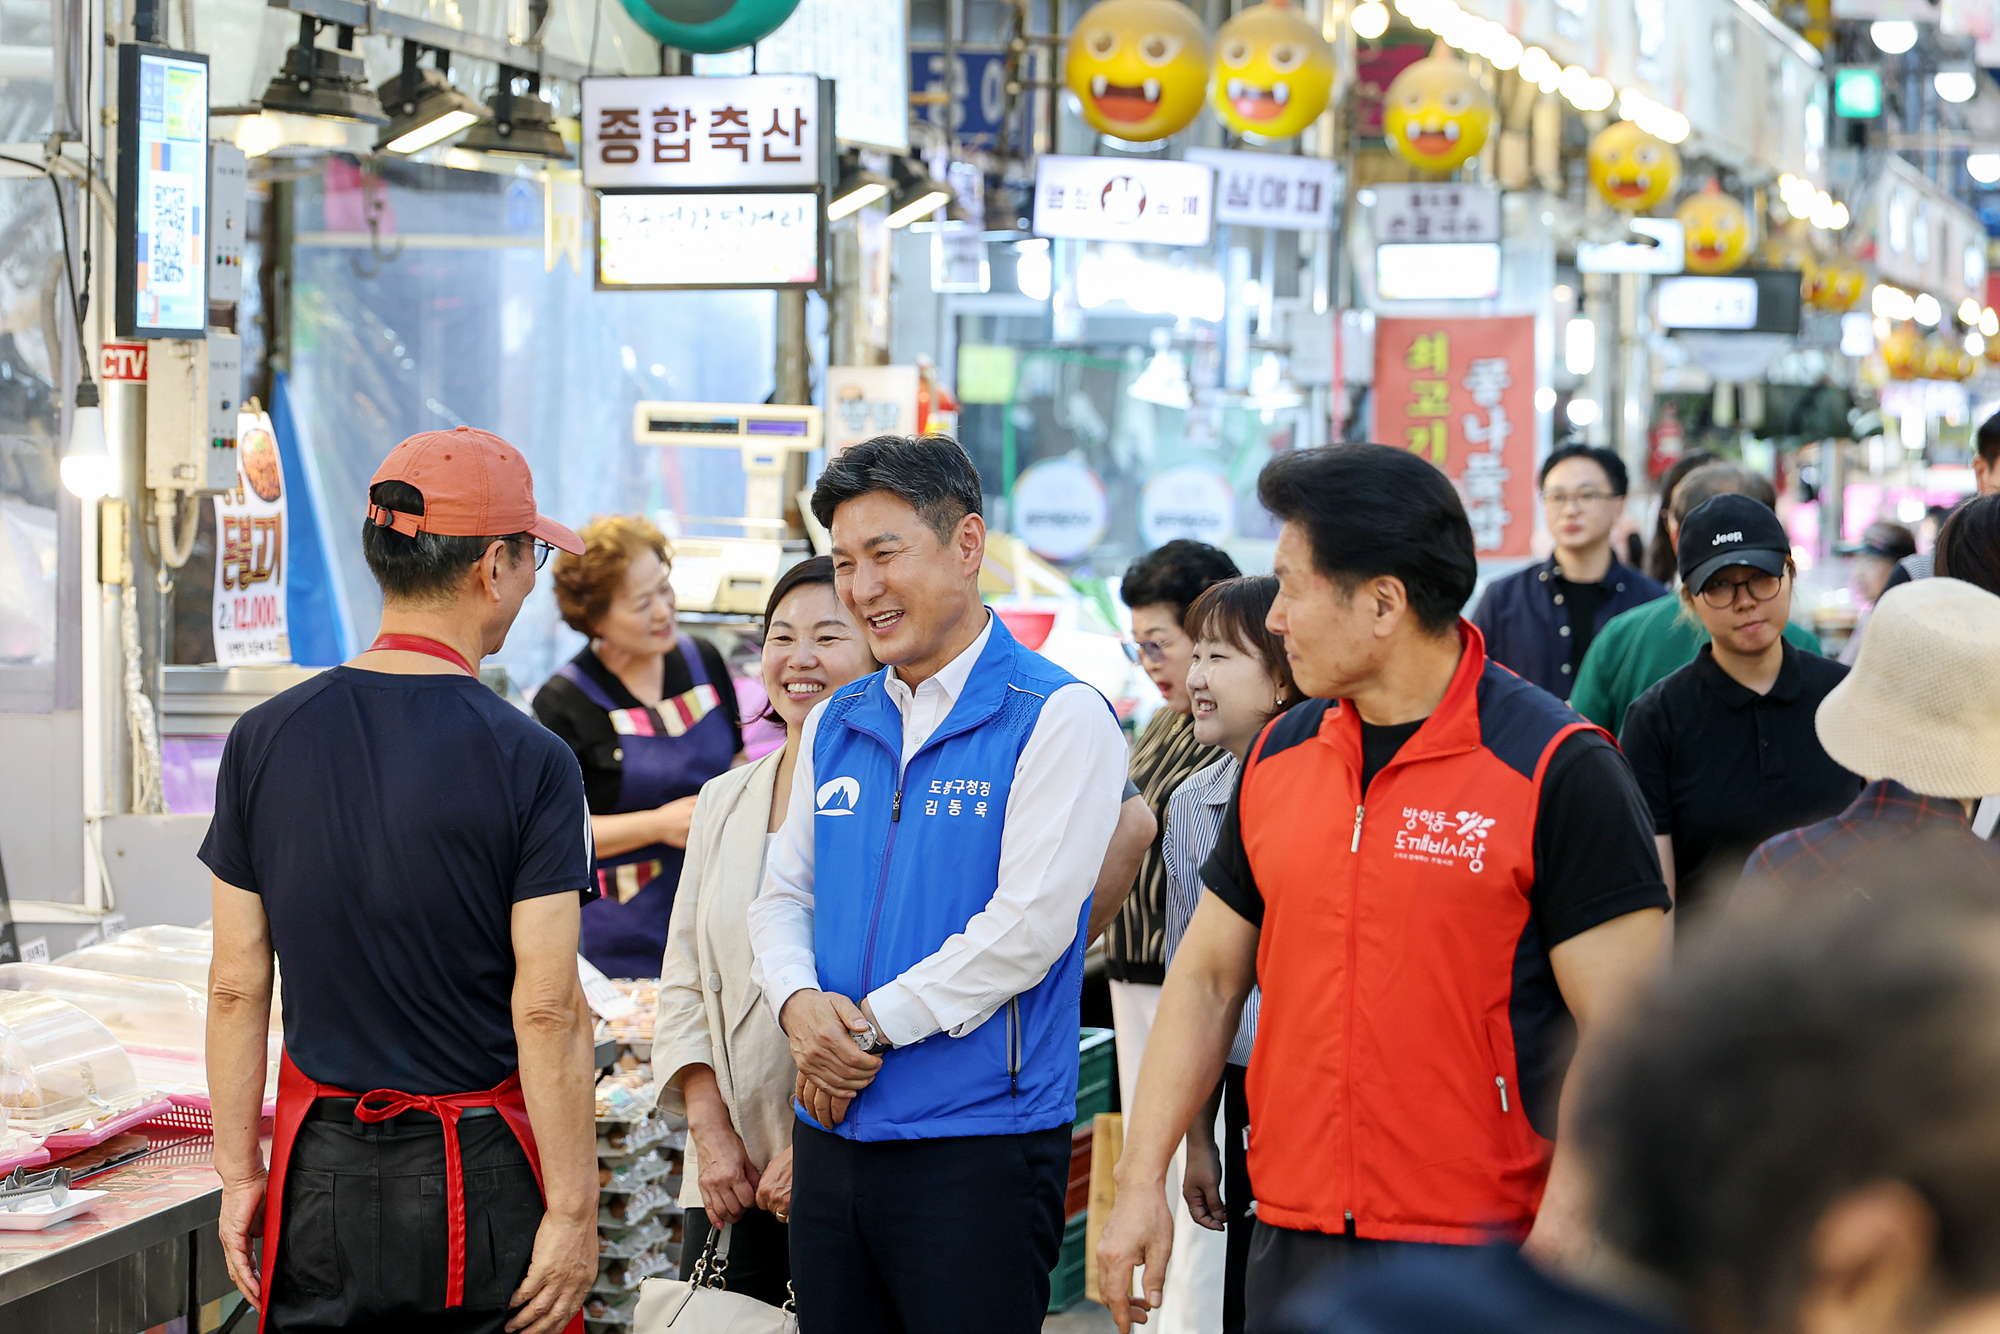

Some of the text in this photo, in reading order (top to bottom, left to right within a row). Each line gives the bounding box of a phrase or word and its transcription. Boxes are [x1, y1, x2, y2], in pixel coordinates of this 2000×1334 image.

[598, 106, 807, 164] 종합축산
[1712, 531, 1743, 546] Jeep
[928, 779, 991, 797] 도봉구청장
[1402, 806, 1457, 833] 방학동
[1394, 830, 1486, 873] 도깨비시장
